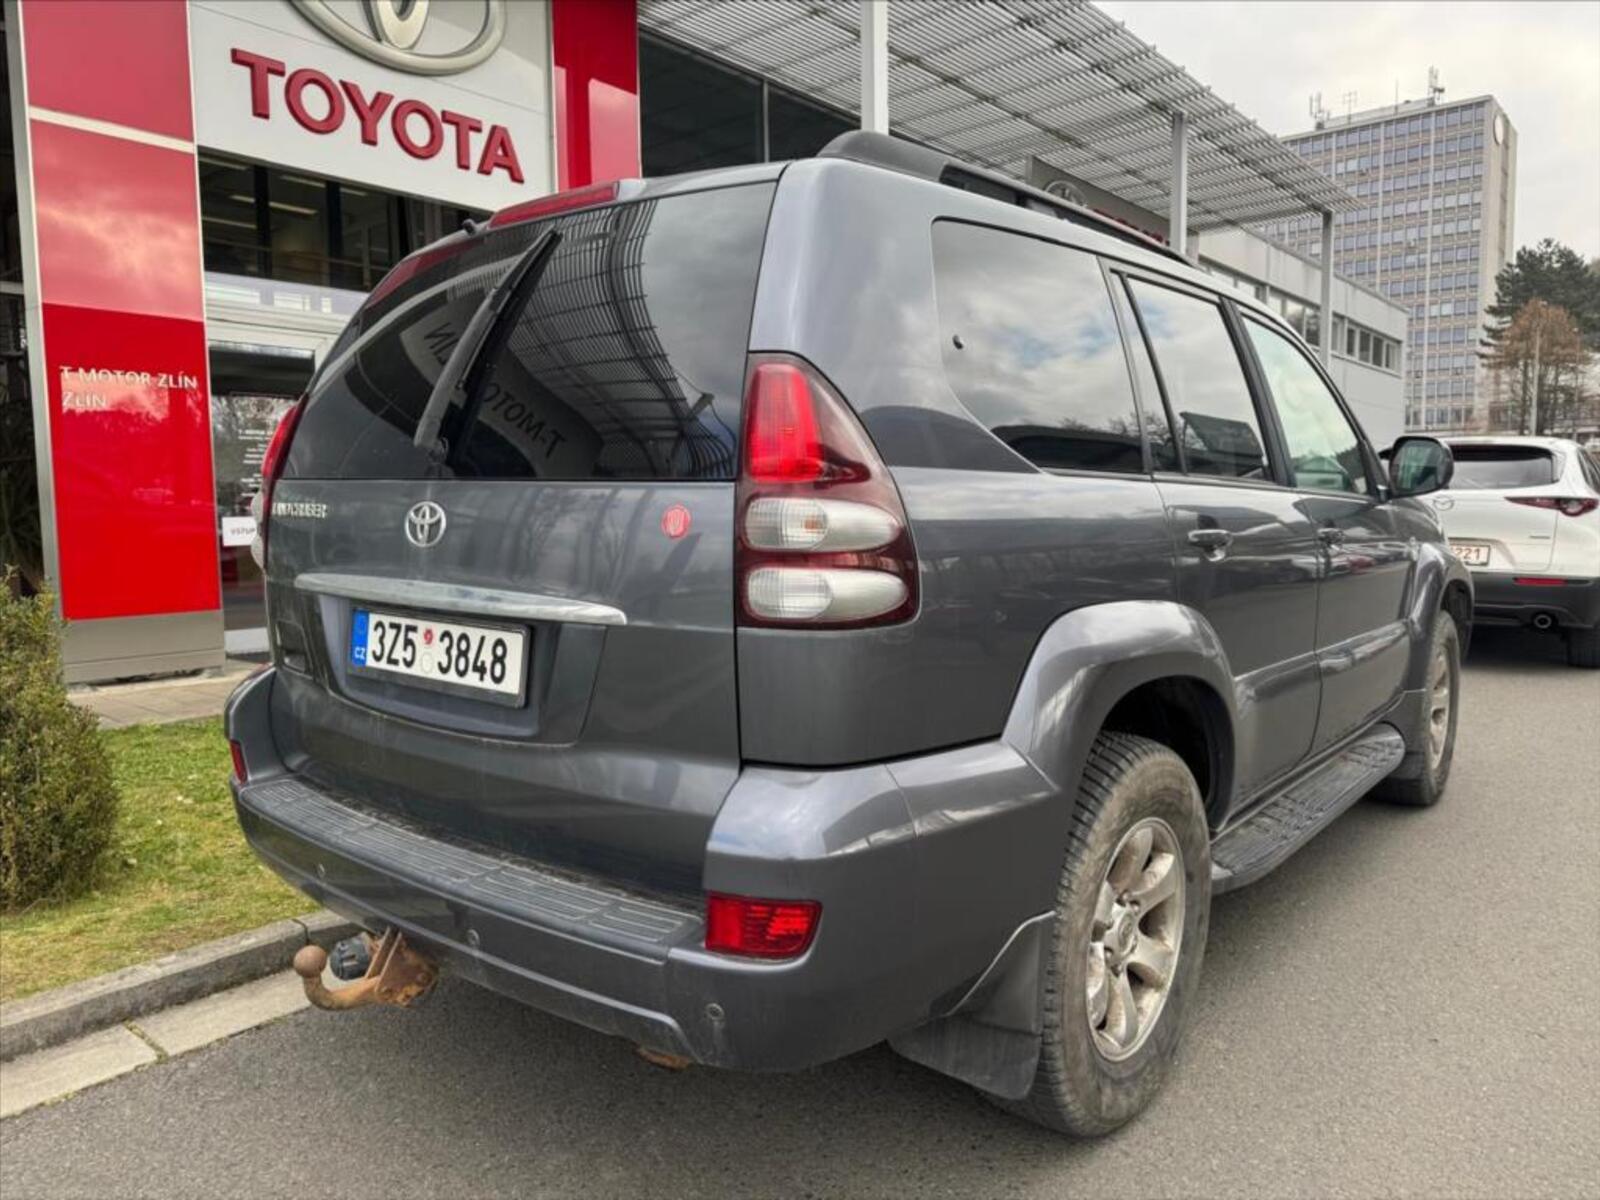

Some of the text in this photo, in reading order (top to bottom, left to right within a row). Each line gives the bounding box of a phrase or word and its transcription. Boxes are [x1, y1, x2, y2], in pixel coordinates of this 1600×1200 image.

[230, 48, 524, 184] TOYOTA
[158, 370, 198, 390] ZLÍN
[1450, 547, 1481, 561] 221
[354, 646, 366, 660] CZ
[372, 620, 508, 684] 3Z5 3848
